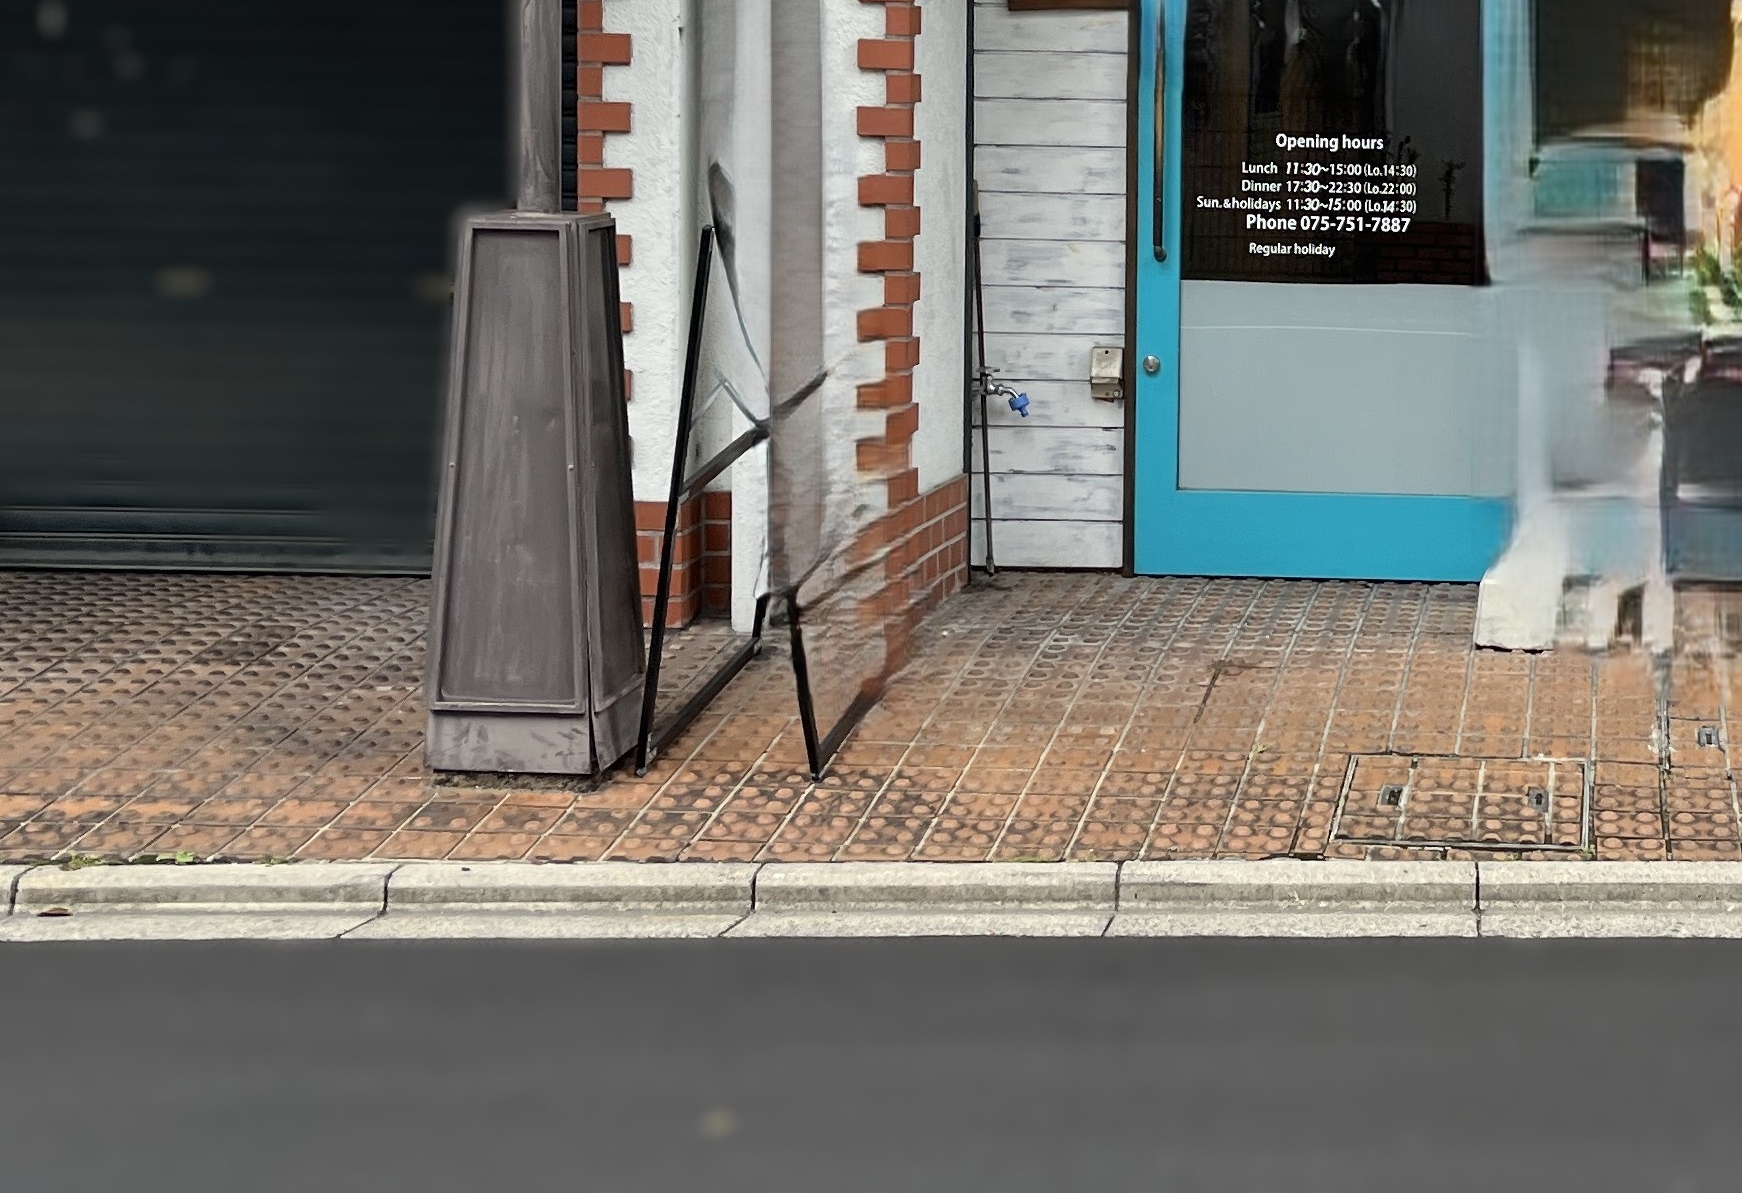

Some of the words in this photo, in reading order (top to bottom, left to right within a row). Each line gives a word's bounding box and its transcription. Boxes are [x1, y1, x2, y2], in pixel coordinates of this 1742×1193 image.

[1275, 133, 1339, 153] Opening
[1341, 133, 1385, 150] hours
[1241, 161, 1279, 174] Lunch
[1241, 179, 1283, 193] Dinner
[1246, 214, 1298, 231] Phone
[1300, 215, 1411, 233] 075-751-7887
[1248, 242, 1292, 257] Regular
[1293, 242, 1336, 258] holiday
